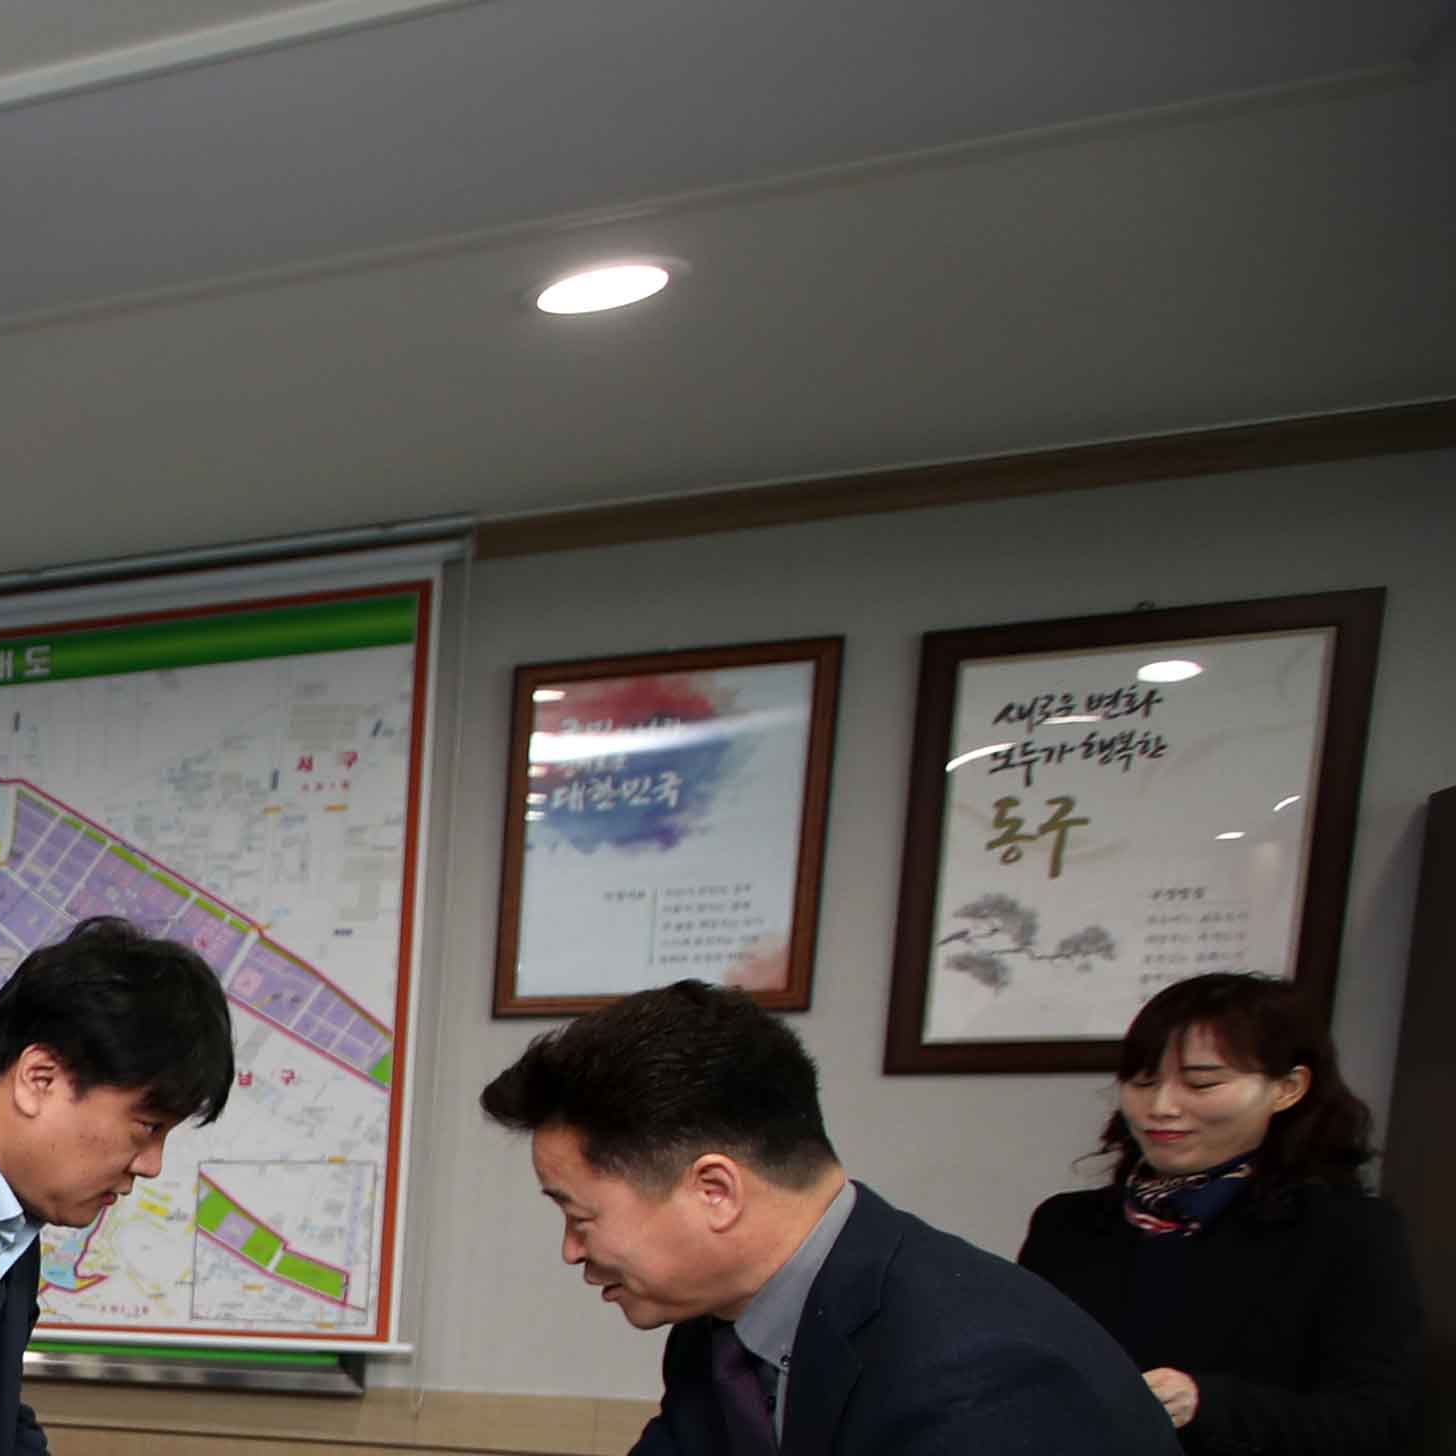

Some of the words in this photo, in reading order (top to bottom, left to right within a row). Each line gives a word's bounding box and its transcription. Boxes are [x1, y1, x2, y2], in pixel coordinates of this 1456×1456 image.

[1085, 684, 1163, 720] 변화
[988, 740, 1075, 787] 모두가
[1081, 730, 1169, 773] 행복한
[549, 768, 683, 812] 대한민국
[985, 795, 1091, 879] 동구
